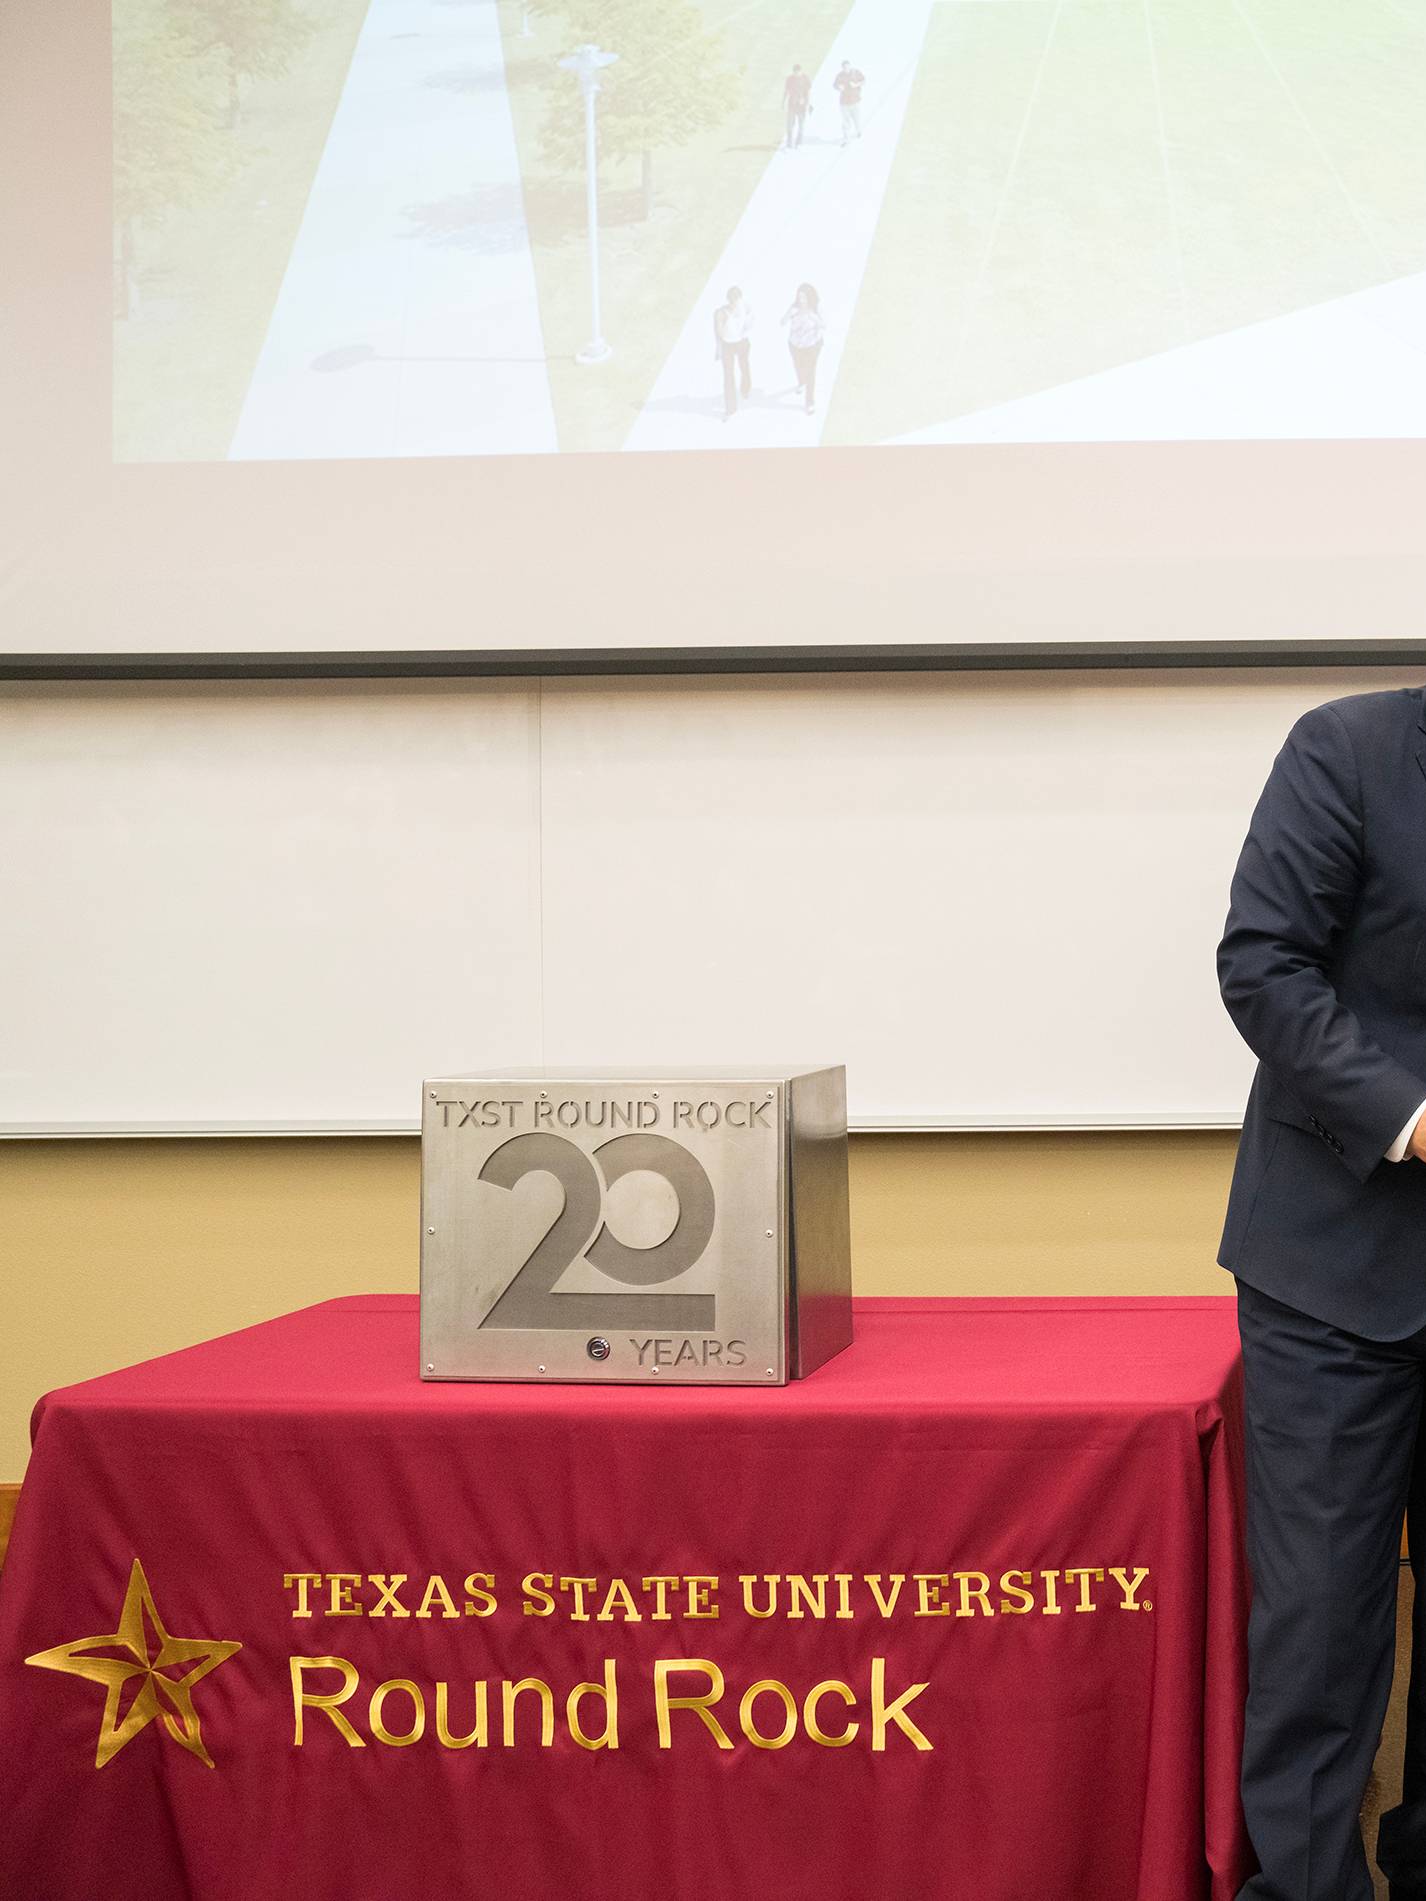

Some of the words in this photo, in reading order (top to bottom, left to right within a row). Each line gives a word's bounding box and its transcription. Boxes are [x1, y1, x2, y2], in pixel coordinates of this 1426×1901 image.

[436, 1099, 524, 1129] TXST
[533, 1100, 661, 1129] ROUND
[672, 1100, 773, 1130] ROCK
[477, 1131, 716, 1332] 20
[628, 1337, 747, 1367] YEARS
[284, 1573, 498, 1619] TEXAS
[522, 1573, 720, 1622] STATE
[289, 1656, 620, 1750] Round
[653, 1658, 934, 1752] Rock
